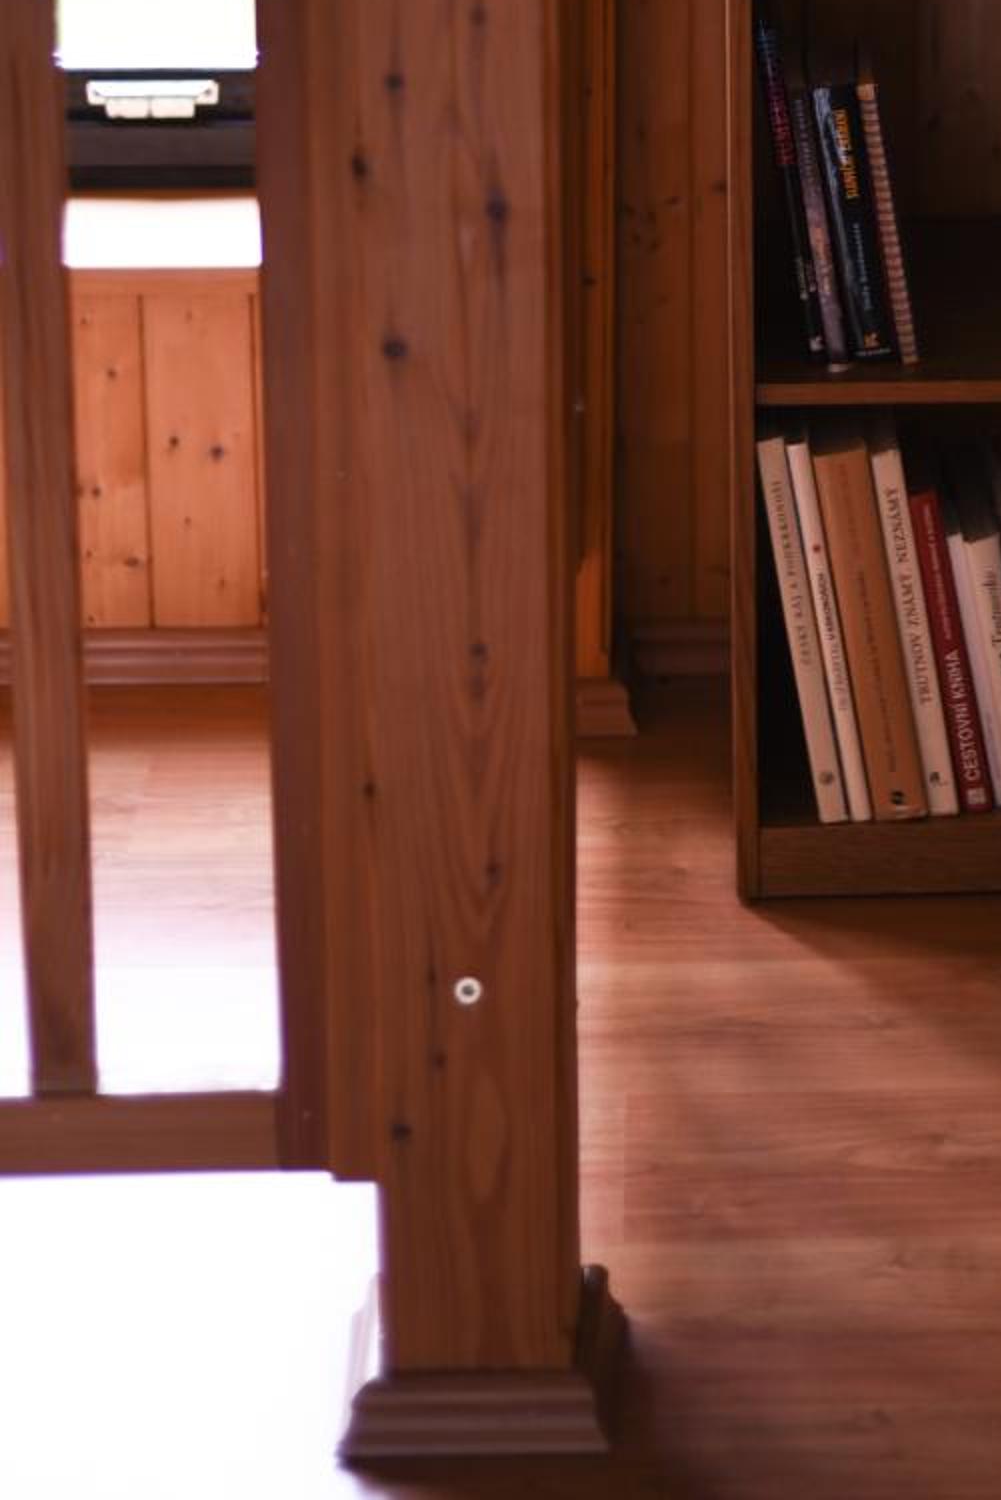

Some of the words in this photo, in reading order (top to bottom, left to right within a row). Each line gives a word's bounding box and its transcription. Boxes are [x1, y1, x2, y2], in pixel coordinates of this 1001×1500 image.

[907, 631, 932, 705] TRUTNOV
[945, 649, 967, 700] KNIHA
[951, 702, 981, 782] CESTOVNÍ
